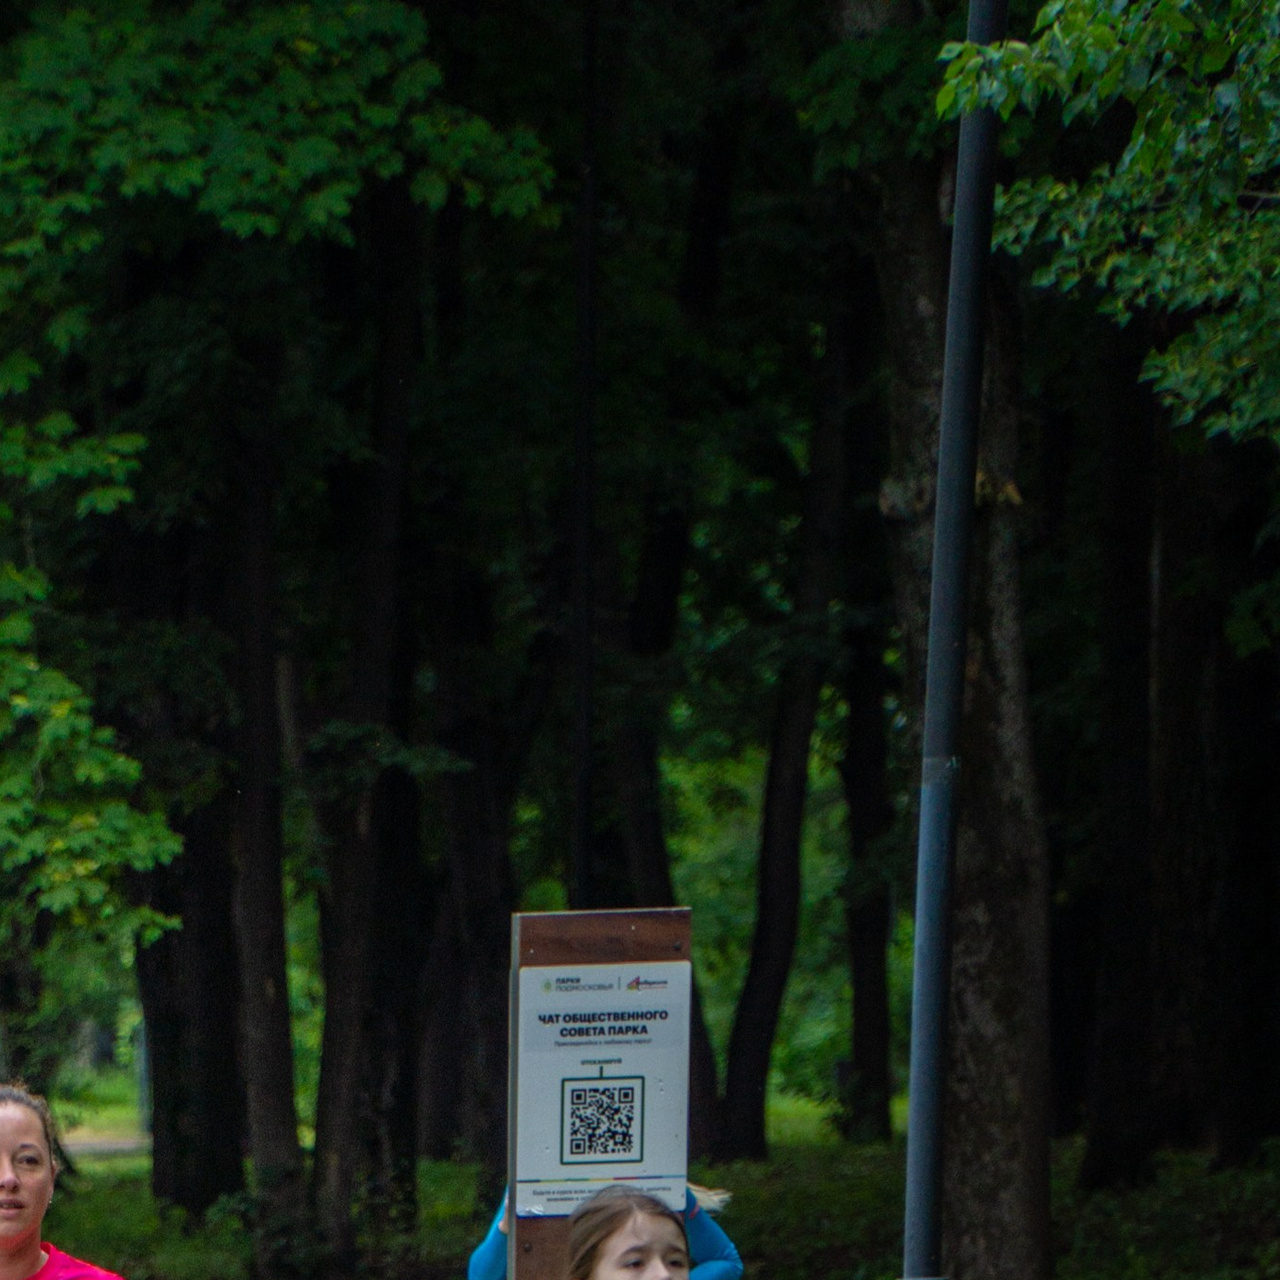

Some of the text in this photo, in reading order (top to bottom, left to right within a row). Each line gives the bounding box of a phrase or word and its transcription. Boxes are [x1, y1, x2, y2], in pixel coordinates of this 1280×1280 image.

[538, 1010, 669, 1025] ЧАТ ОБЩЕСТВЕННОГО
[560, 1025, 648, 1037] СОВЕТА ПАРКА
